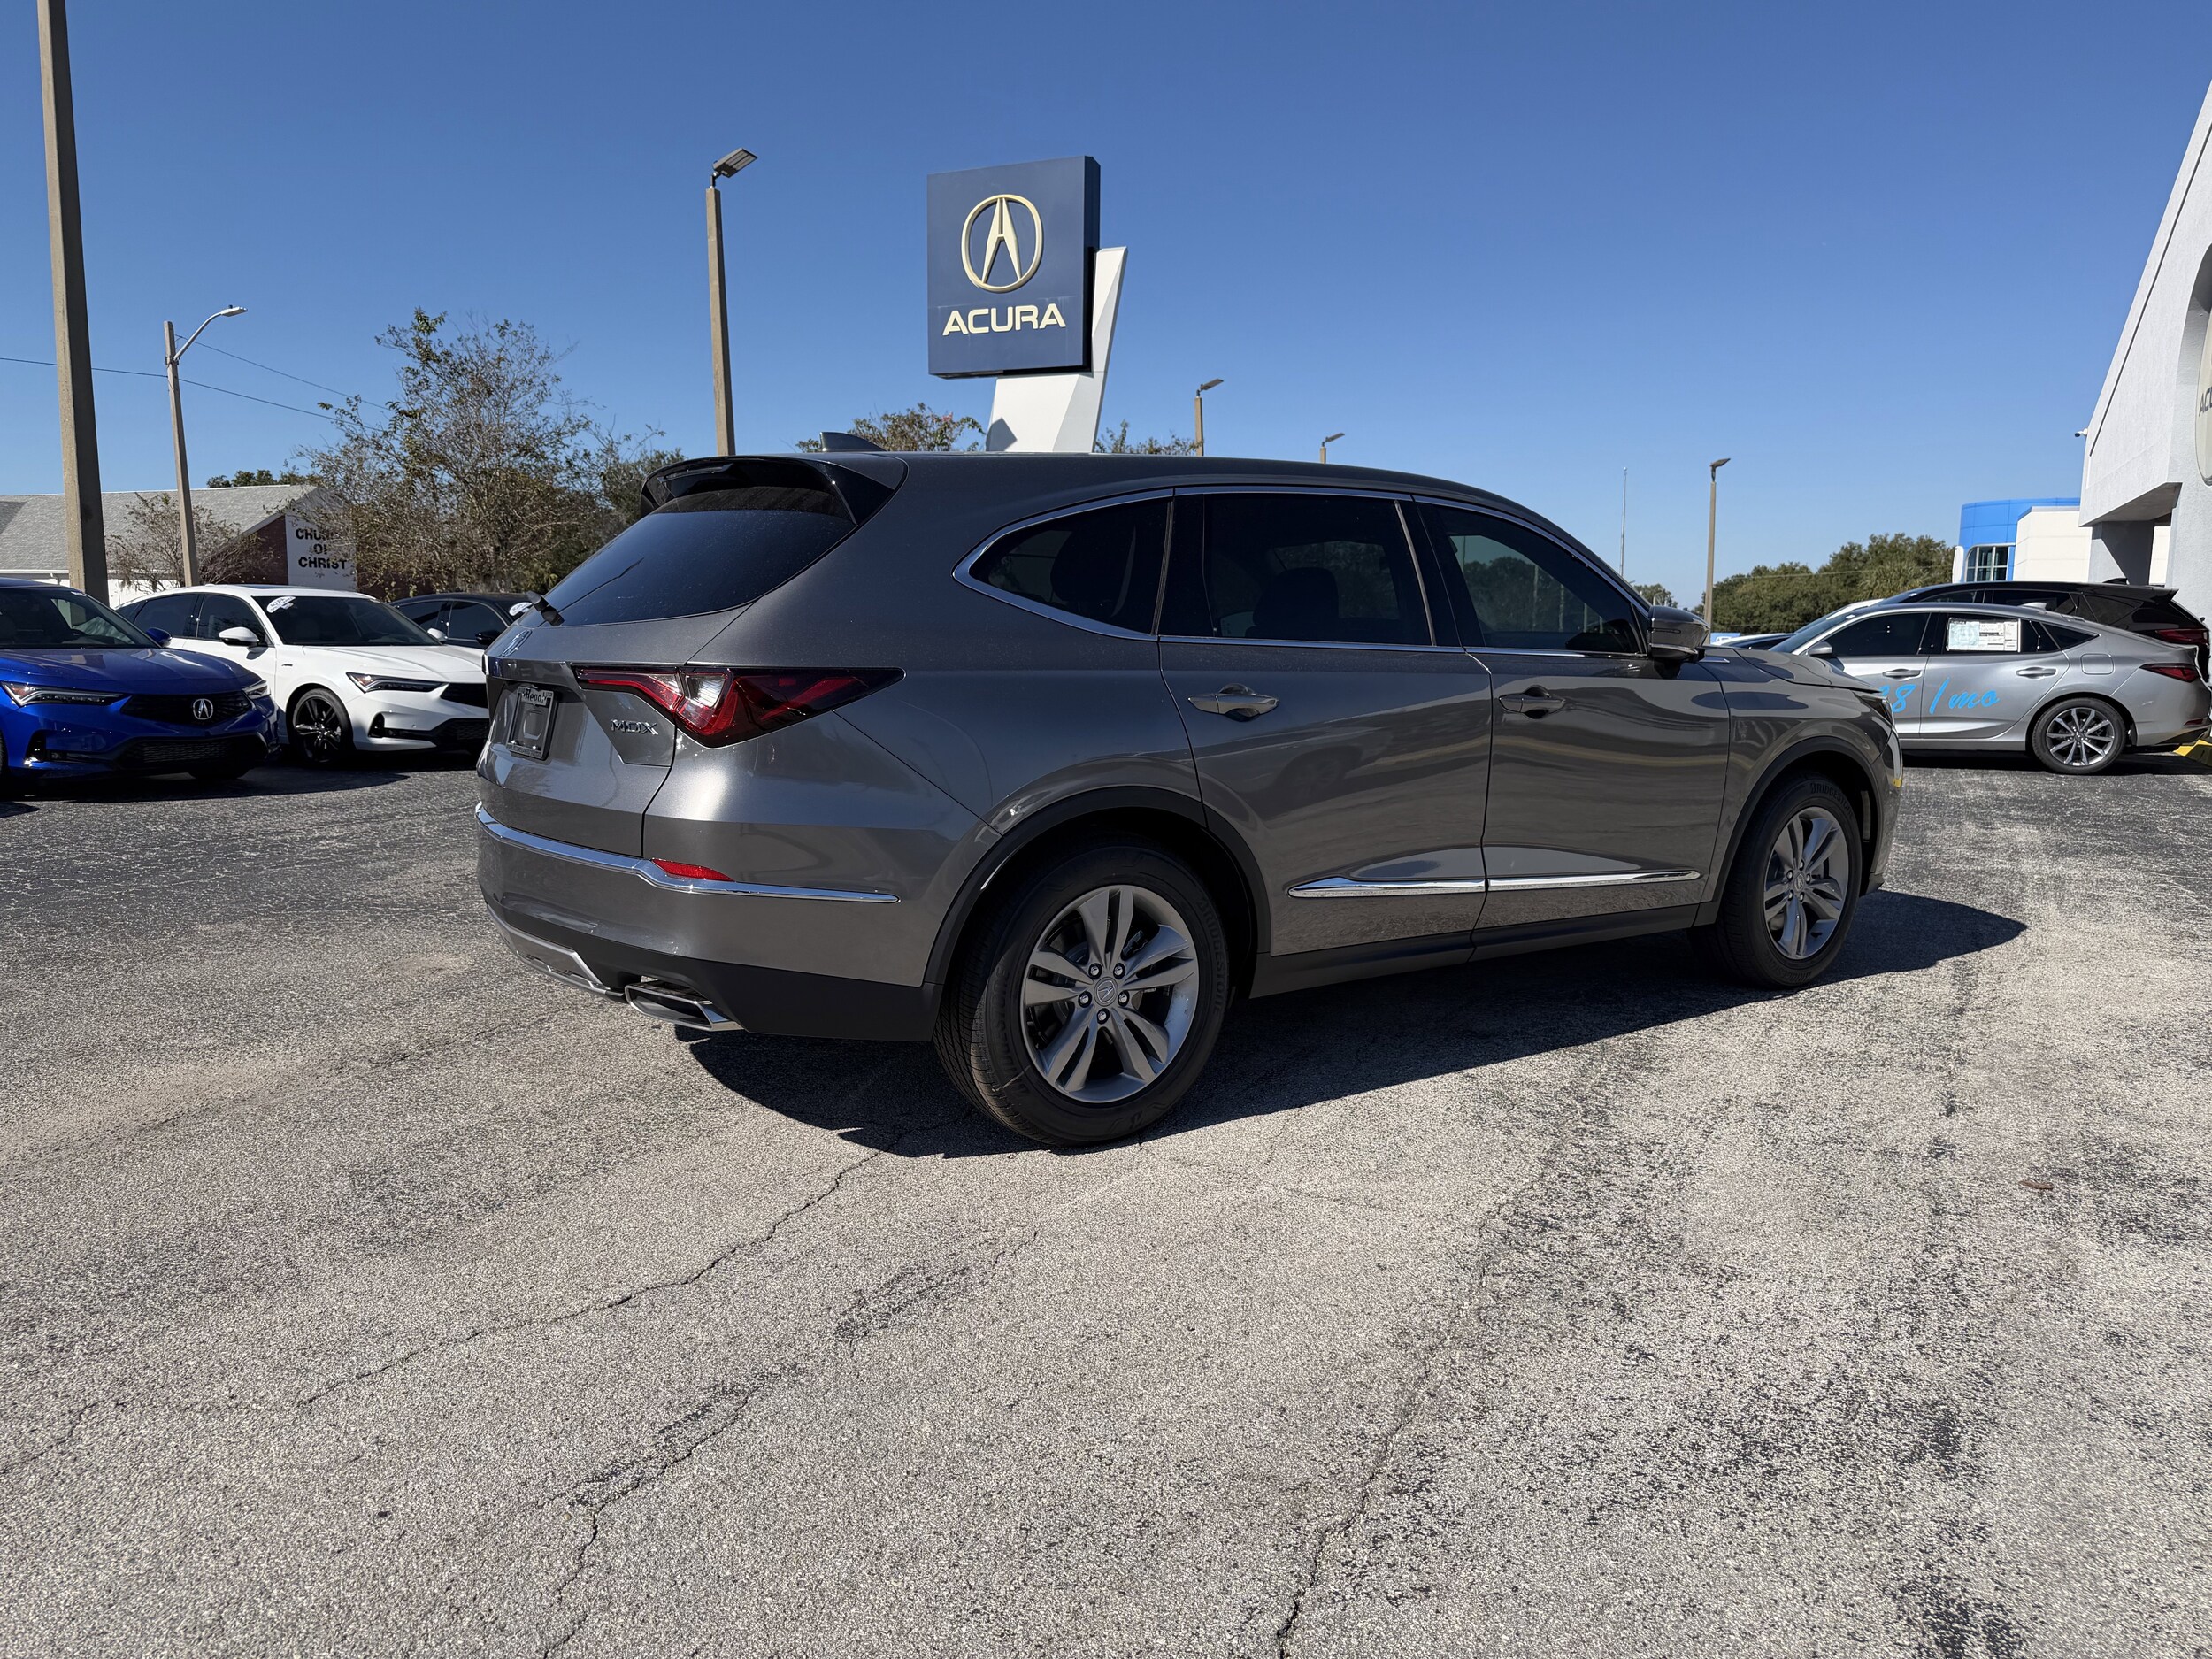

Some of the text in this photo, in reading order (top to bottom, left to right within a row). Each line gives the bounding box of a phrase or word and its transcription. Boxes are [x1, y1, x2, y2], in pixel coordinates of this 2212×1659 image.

[942, 303, 1066, 335] ACURA
[298, 557, 347, 569] CHRIST
[611, 719, 658, 735] MDX
